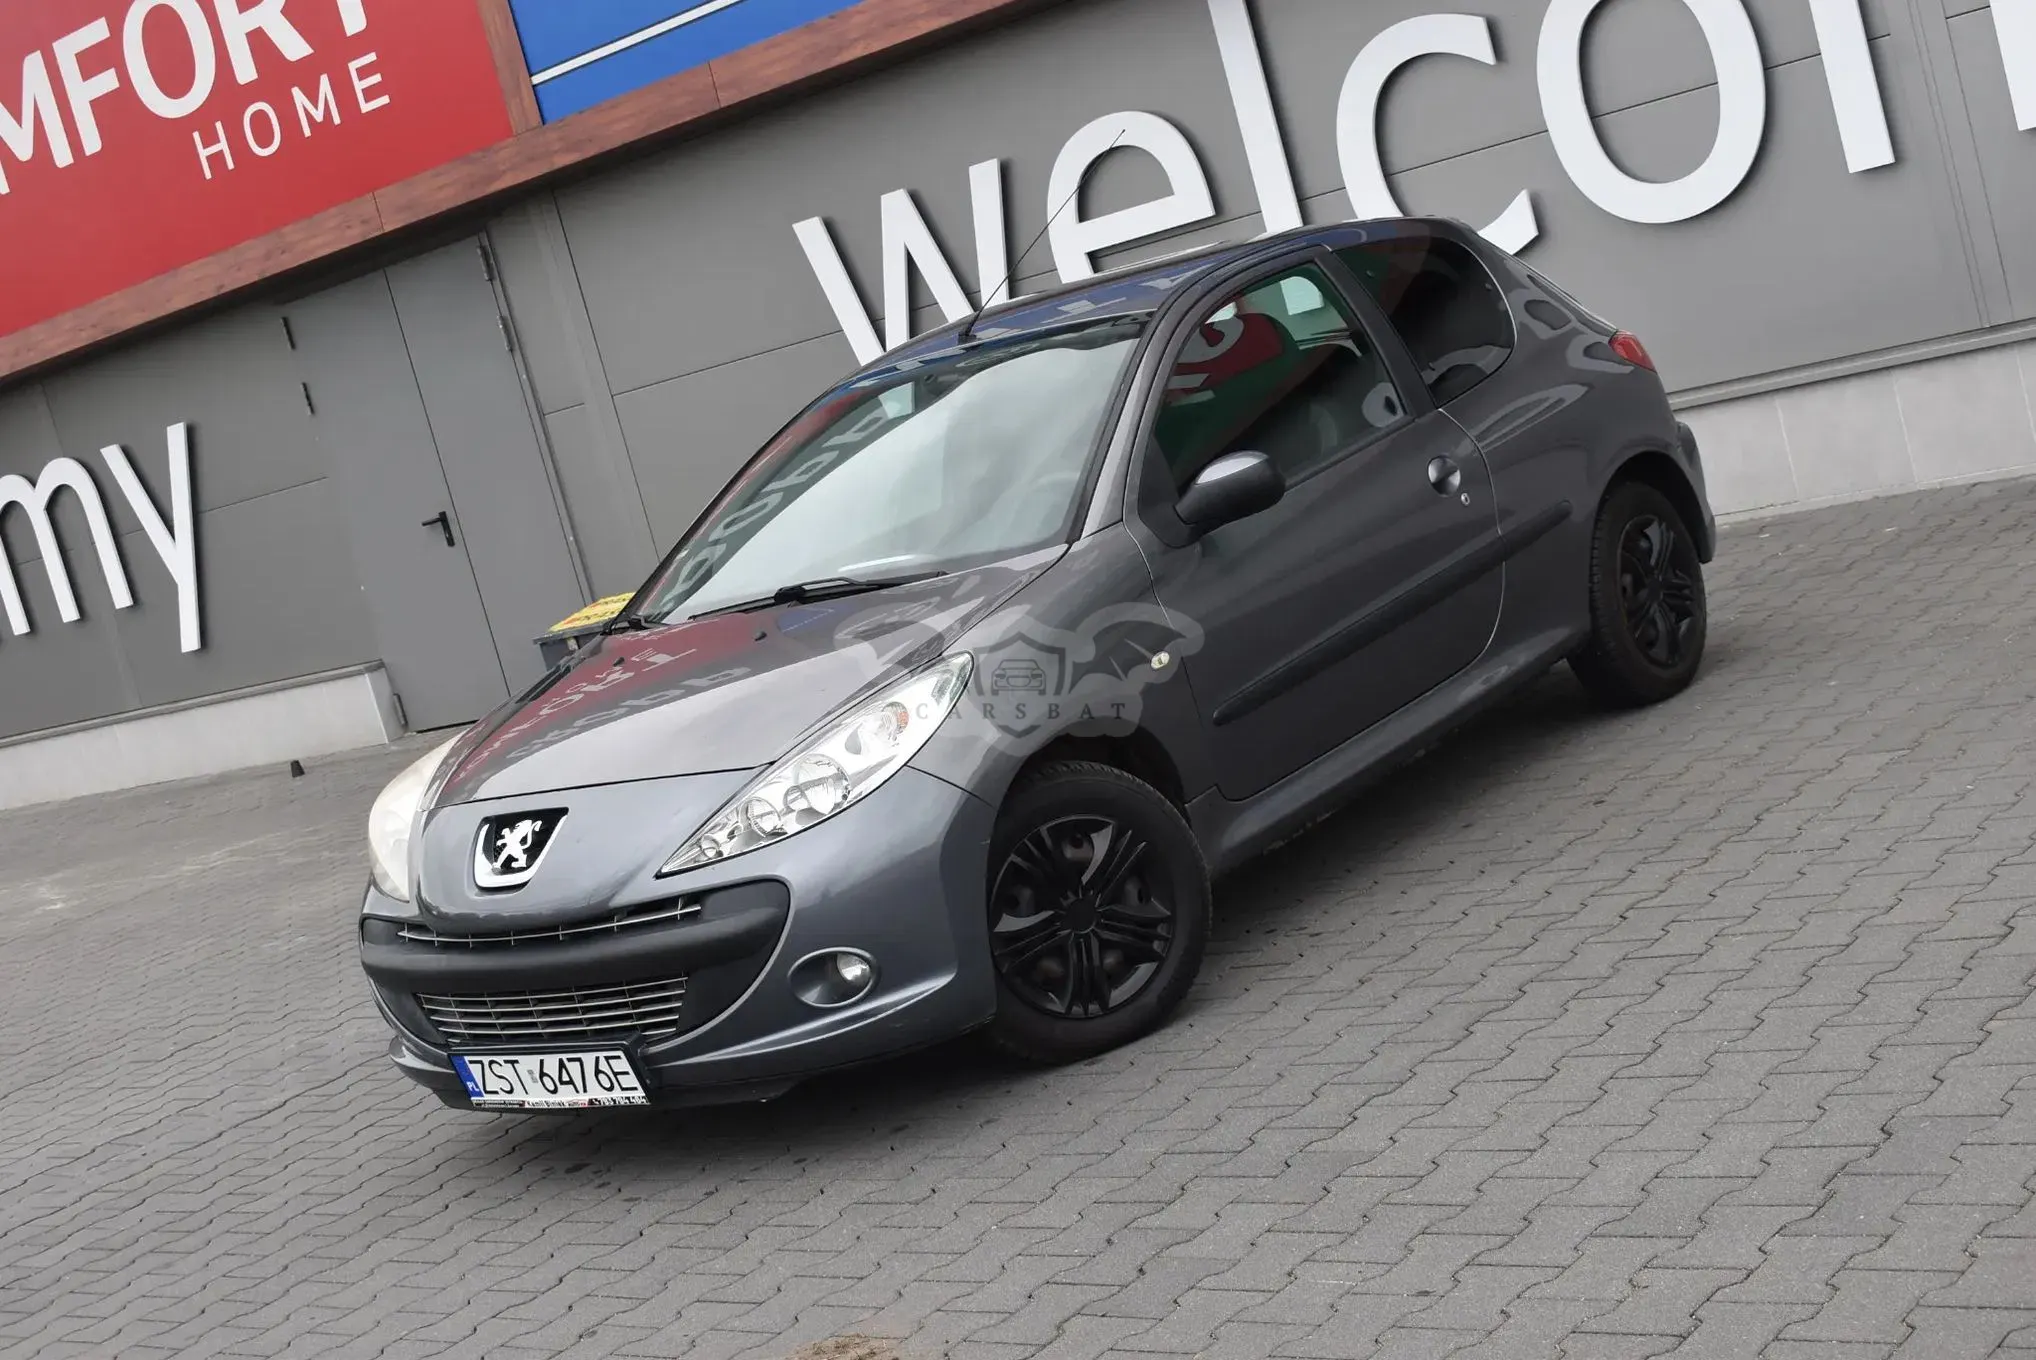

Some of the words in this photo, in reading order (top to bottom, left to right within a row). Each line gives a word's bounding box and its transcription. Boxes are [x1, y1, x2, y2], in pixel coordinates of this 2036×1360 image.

[192, 51, 391, 181] HOME
[0, 421, 201, 653] my
[466, 1081, 480, 1092] PL
[468, 1059, 528, 1095] ZST
[538, 1055, 639, 1095] 6476E
